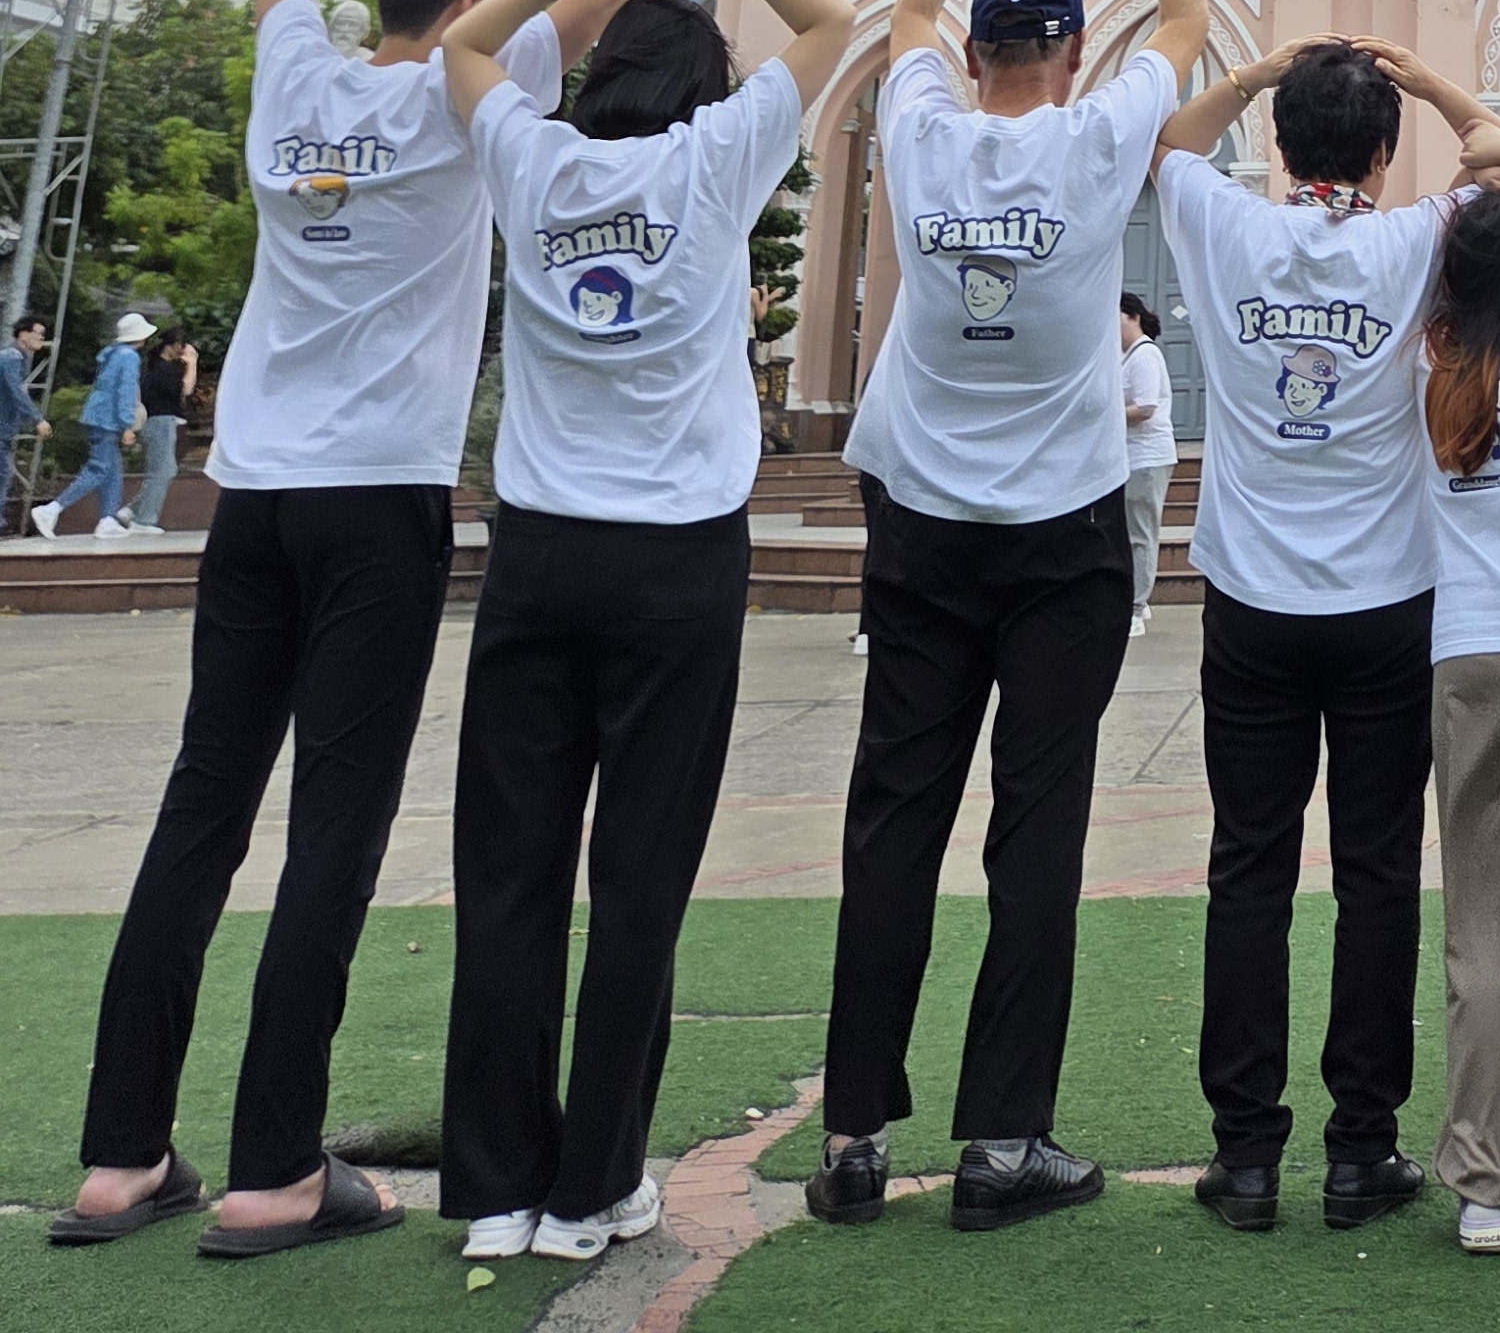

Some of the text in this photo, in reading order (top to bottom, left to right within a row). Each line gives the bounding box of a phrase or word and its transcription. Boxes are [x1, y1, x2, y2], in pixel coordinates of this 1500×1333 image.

[914, 206, 1066, 259] Family
[971, 328, 1007, 338] Father
[1237, 296, 1392, 359] Family
[1284, 423, 1326, 437] Mother
